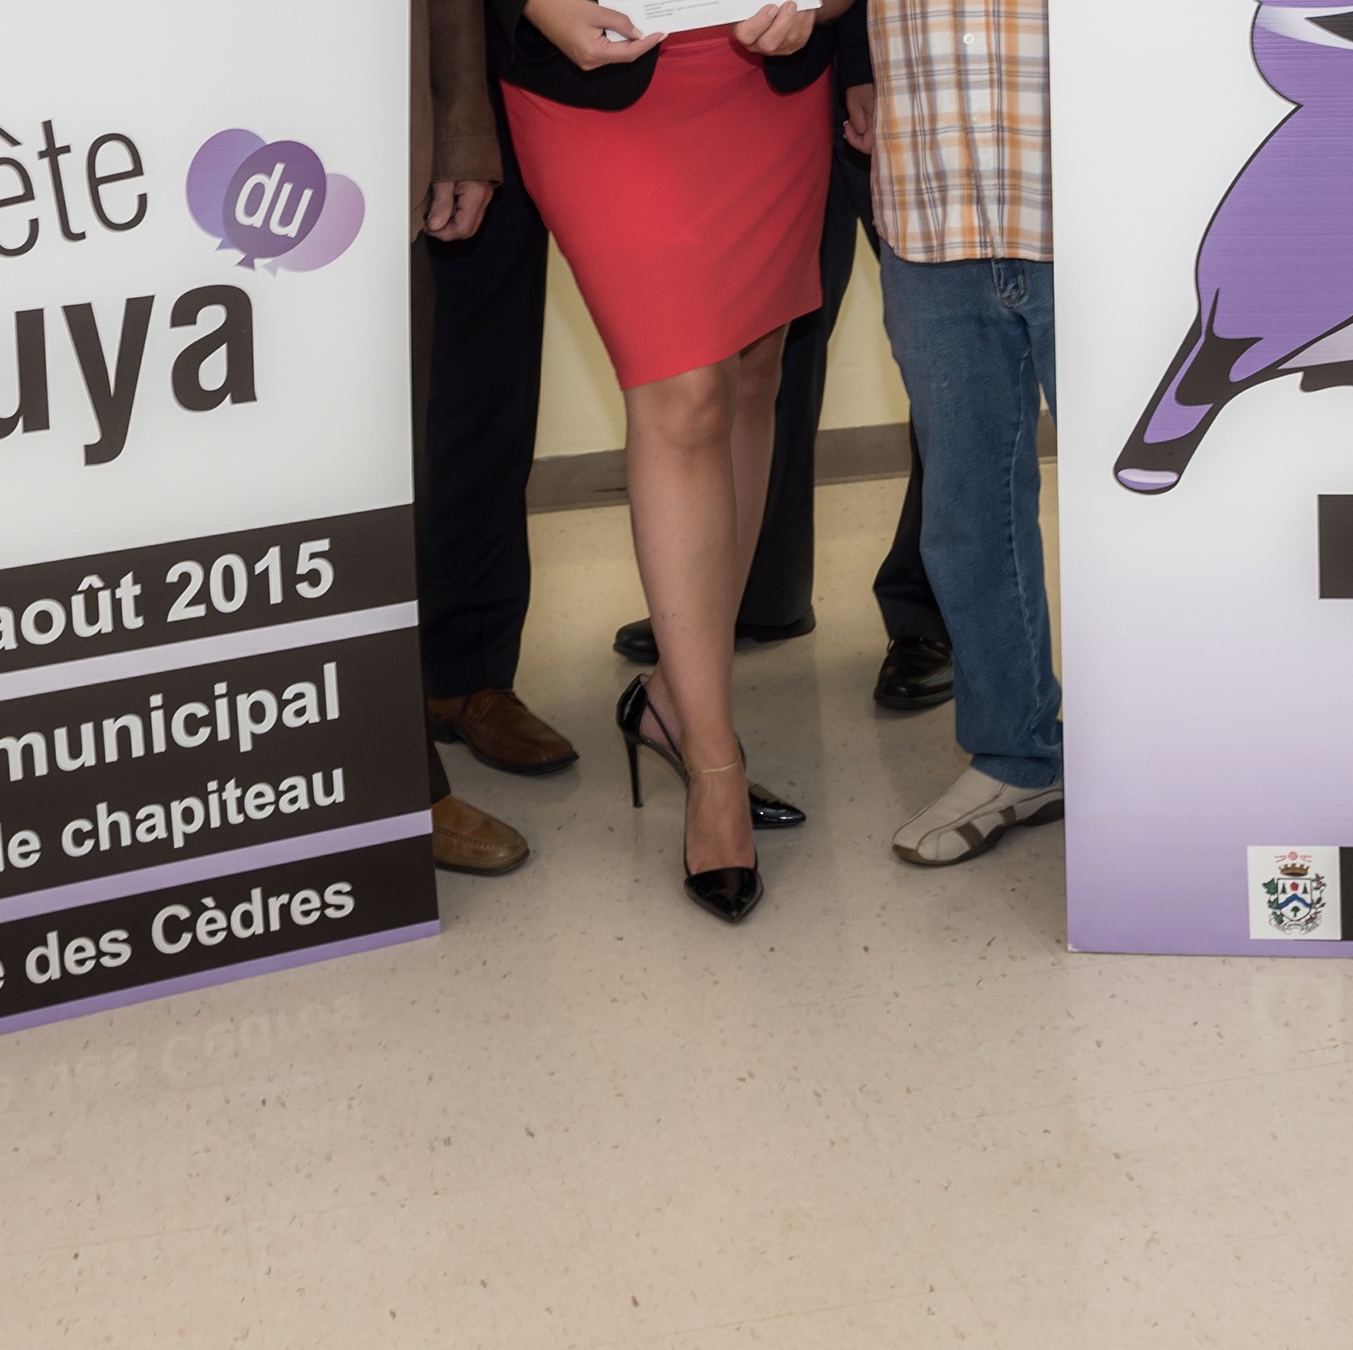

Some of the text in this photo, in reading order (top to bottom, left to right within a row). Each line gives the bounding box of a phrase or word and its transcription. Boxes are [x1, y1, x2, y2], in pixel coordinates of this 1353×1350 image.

[233, 159, 316, 240] du
[164, 536, 335, 624] 2015
[60, 766, 346, 858] chapiteau
[24, 928, 133, 985] des
[150, 881, 356, 955] Cèdres
